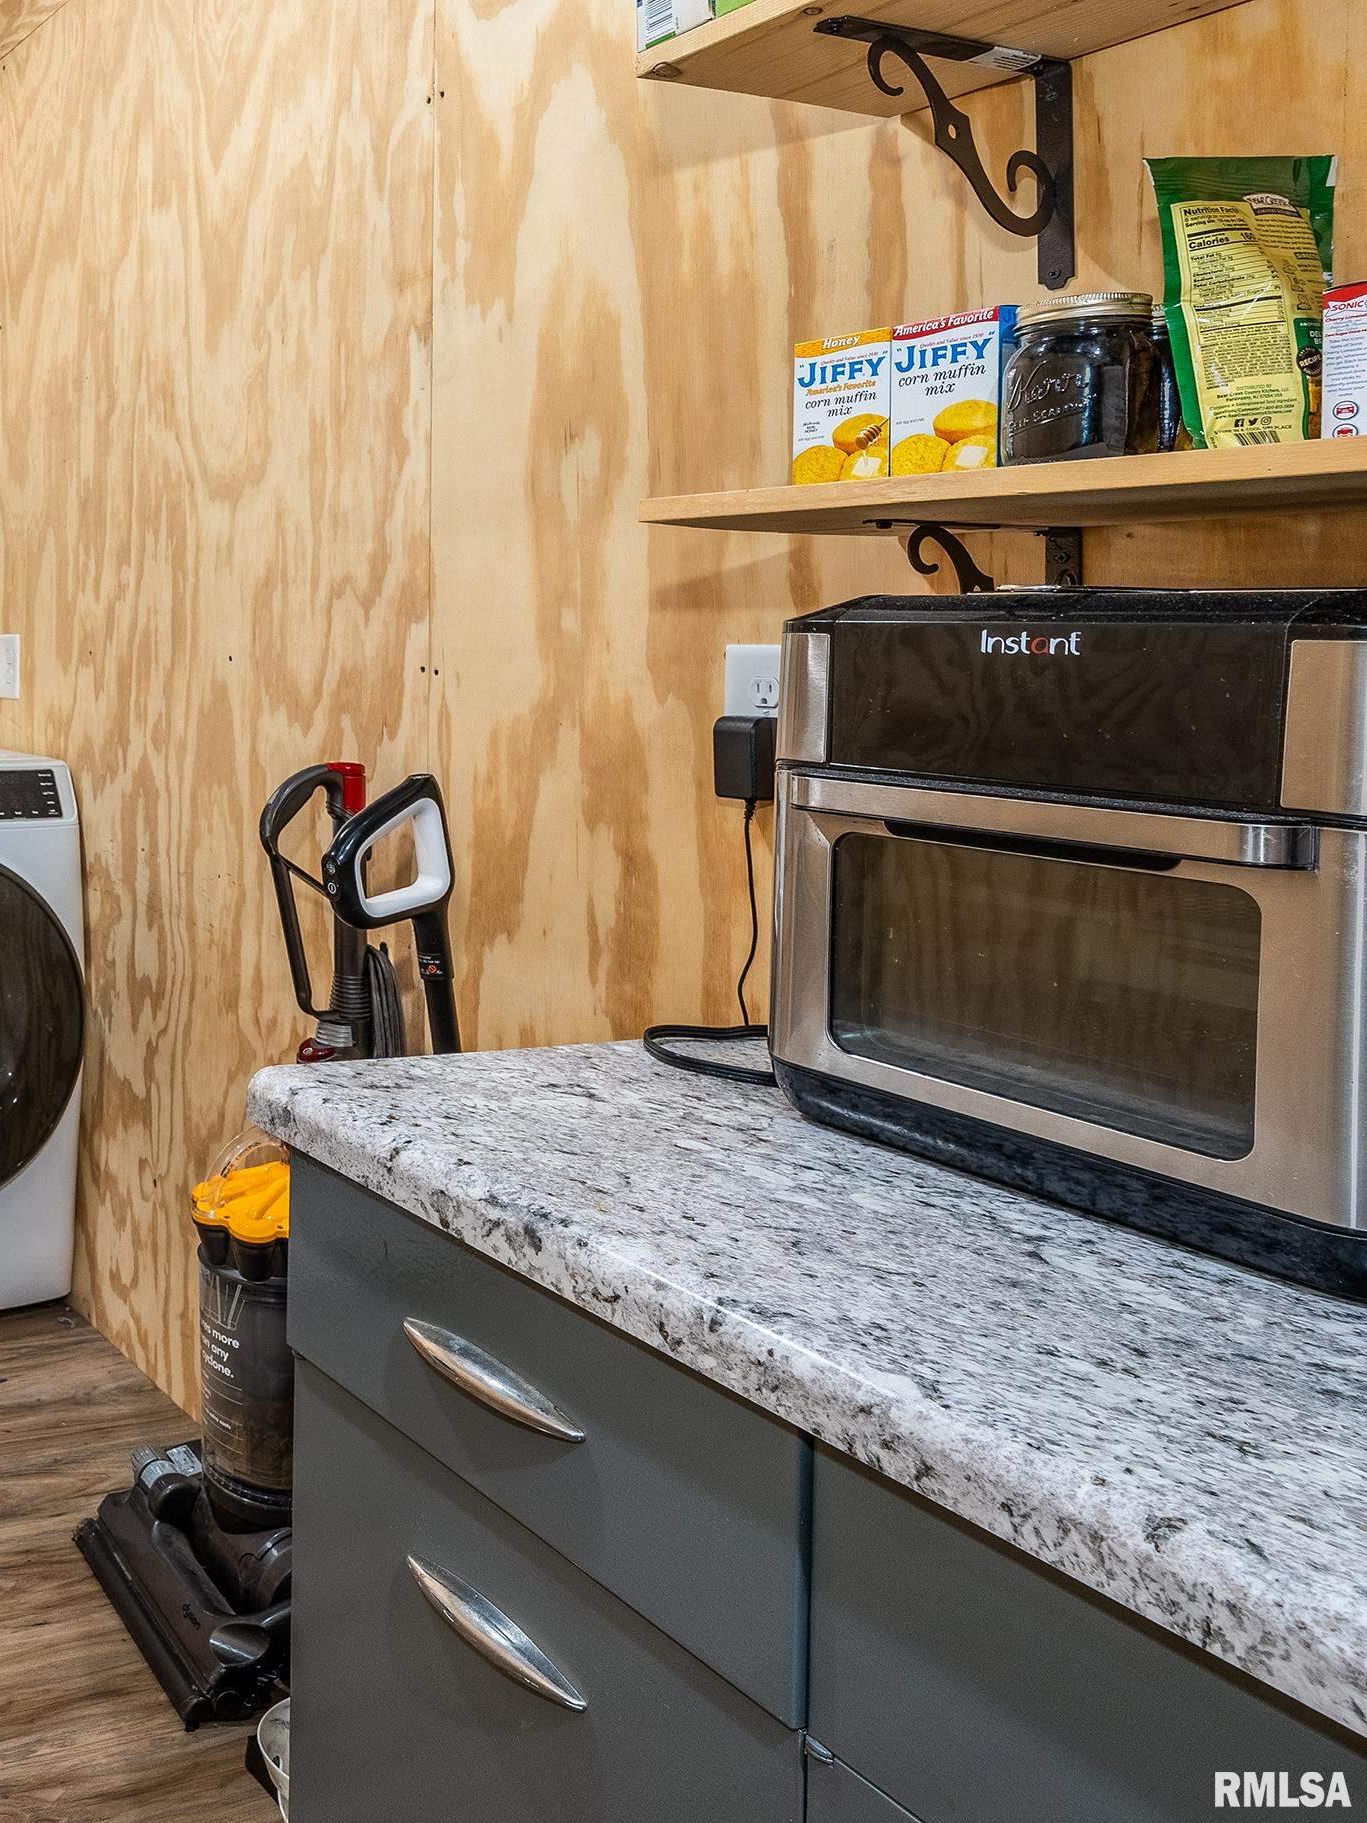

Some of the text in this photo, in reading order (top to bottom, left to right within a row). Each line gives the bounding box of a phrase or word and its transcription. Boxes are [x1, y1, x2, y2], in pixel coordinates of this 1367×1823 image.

[1183, 206, 1240, 217] Nutrition Facts
[1185, 220, 1206, 228] Serving
[1188, 236, 1230, 249] Calories
[1331, 300, 1364, 312] SONIC
[894, 309, 994, 337] America's Favorite
[822, 335, 861, 350] Honey
[898, 363, 986, 387] corn muffin
[806, 380, 876, 397] America's Favorite
[924, 382, 956, 396] mix
[805, 390, 877, 409] corn muffin
[827, 405, 853, 417] mix
[980, 629, 1082, 655] Instant
[212, 1327, 240, 1349] more
[211, 1344, 229, 1362] any
